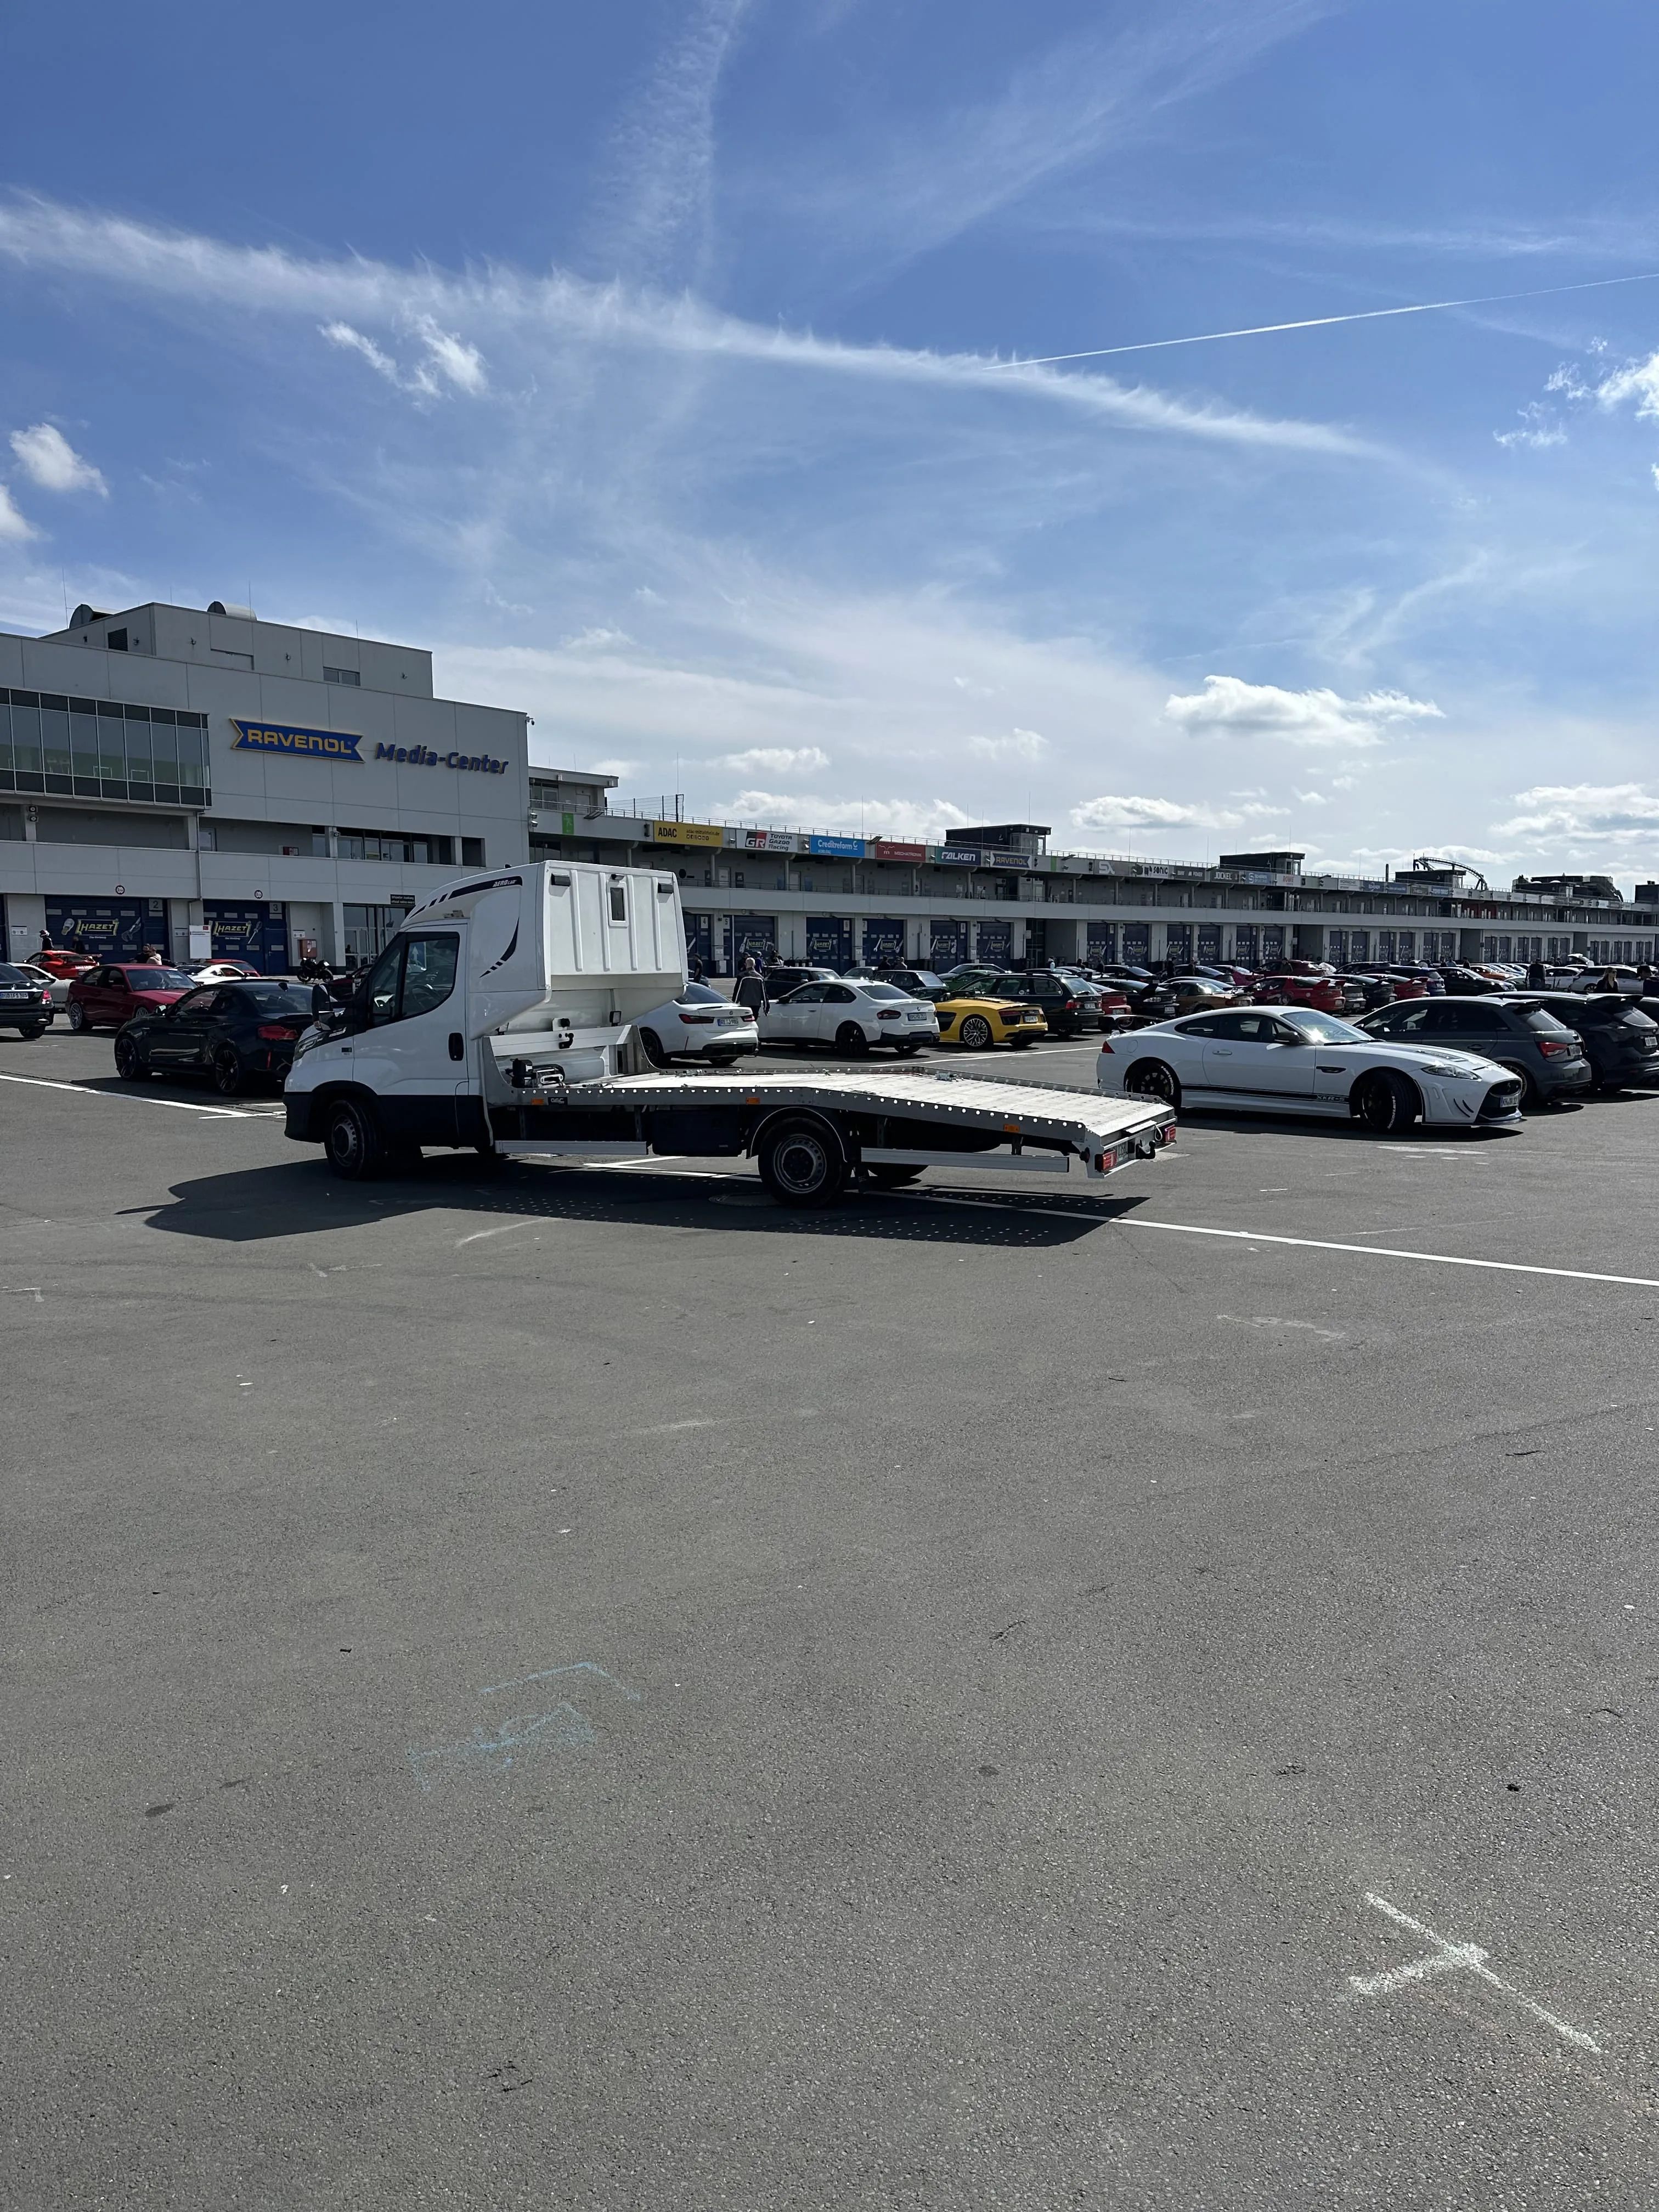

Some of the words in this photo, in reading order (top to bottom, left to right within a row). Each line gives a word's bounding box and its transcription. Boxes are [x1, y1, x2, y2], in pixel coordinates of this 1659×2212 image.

[247, 729, 352, 754] RAVENOL
[375, 742, 509, 774] Media-Center
[658, 827, 677, 838] ADAC
[746, 837, 766, 848] GR
[817, 839, 853, 850] Creditreform
[941, 851, 976, 862] FALKEN
[996, 856, 1028, 865] RAVENOL
[153, 900, 159, 909] 2
[273, 904, 278, 912] 3
[81, 923, 114, 932] HAZET
